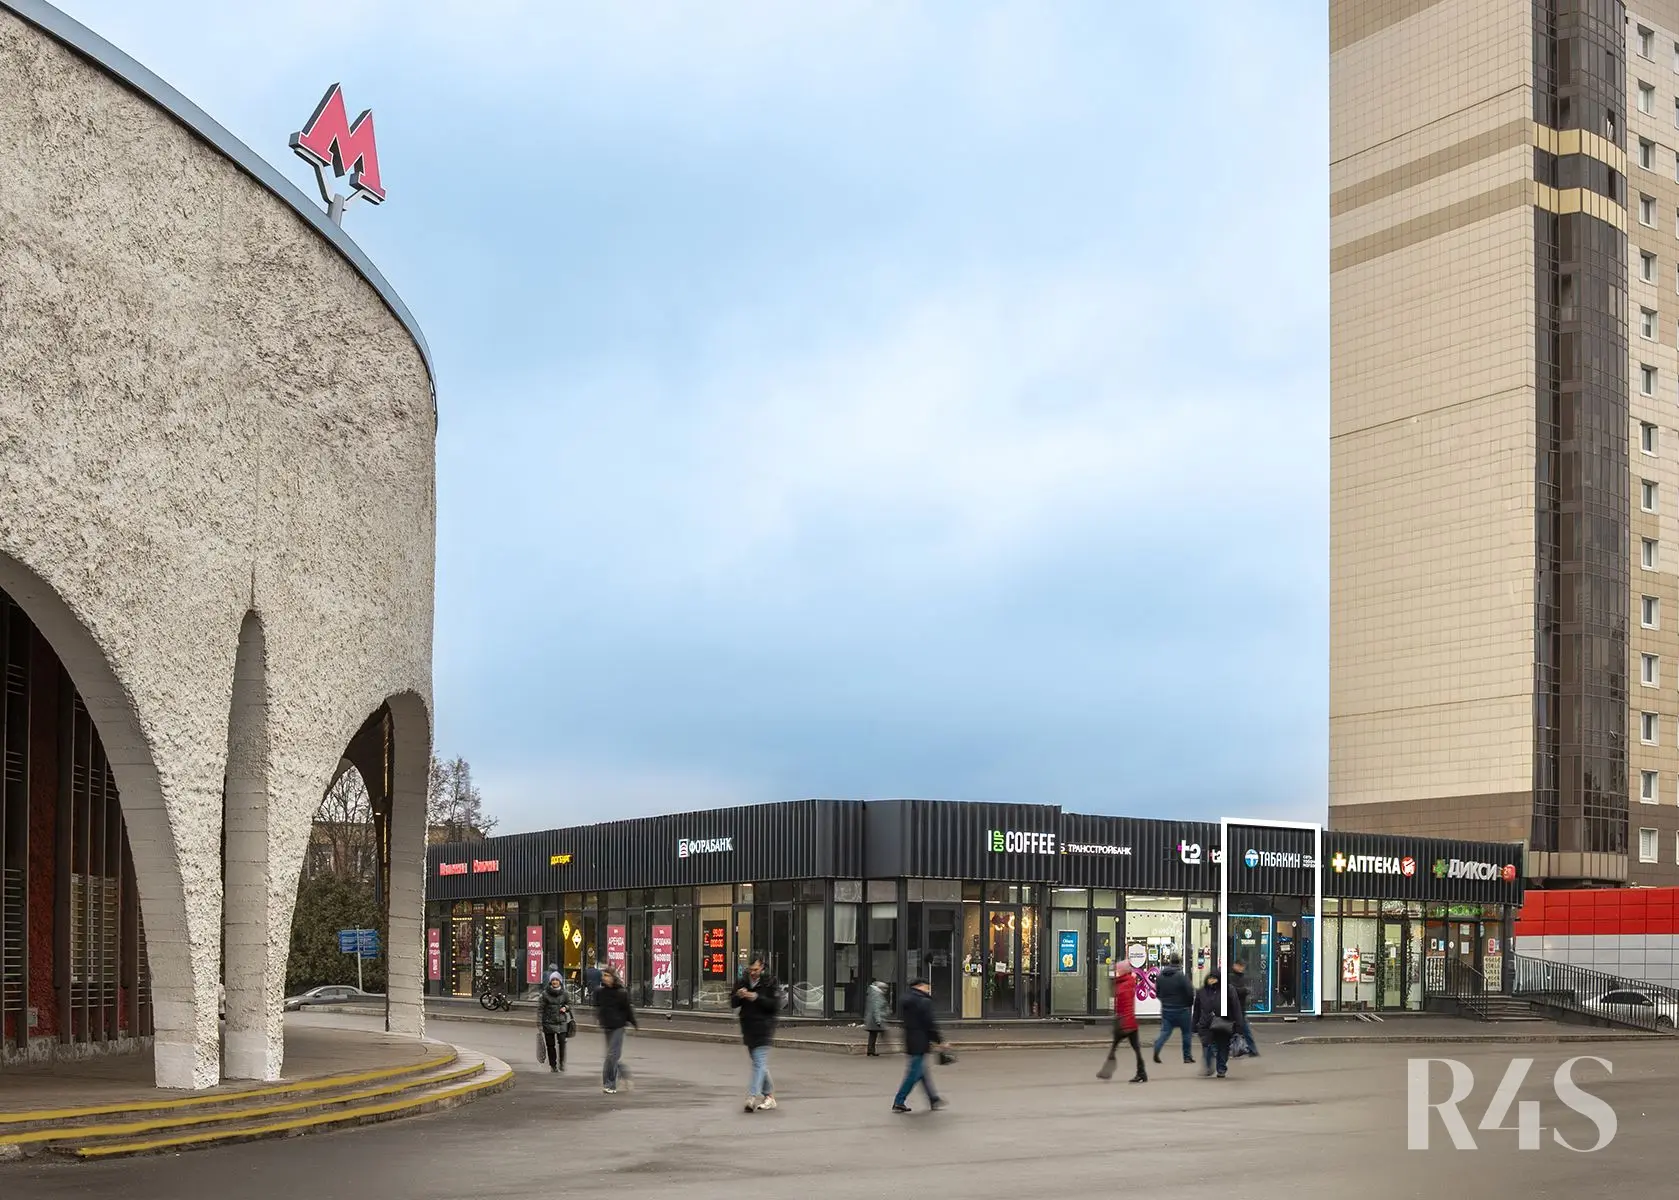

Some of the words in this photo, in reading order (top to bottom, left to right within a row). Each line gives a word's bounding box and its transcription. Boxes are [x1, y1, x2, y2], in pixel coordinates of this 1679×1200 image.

[689, 837, 733, 854] ФОРАБАНК
[993, 830, 1004, 852] CUP
[1005, 830, 1055, 855] COFFEE
[1177, 840, 1200, 864] t2
[1259, 851, 1300, 868] ТАБАКИН
[1347, 855, 1401, 874] АПТЕКА
[1447, 859, 1497, 881] ДИКСИ
